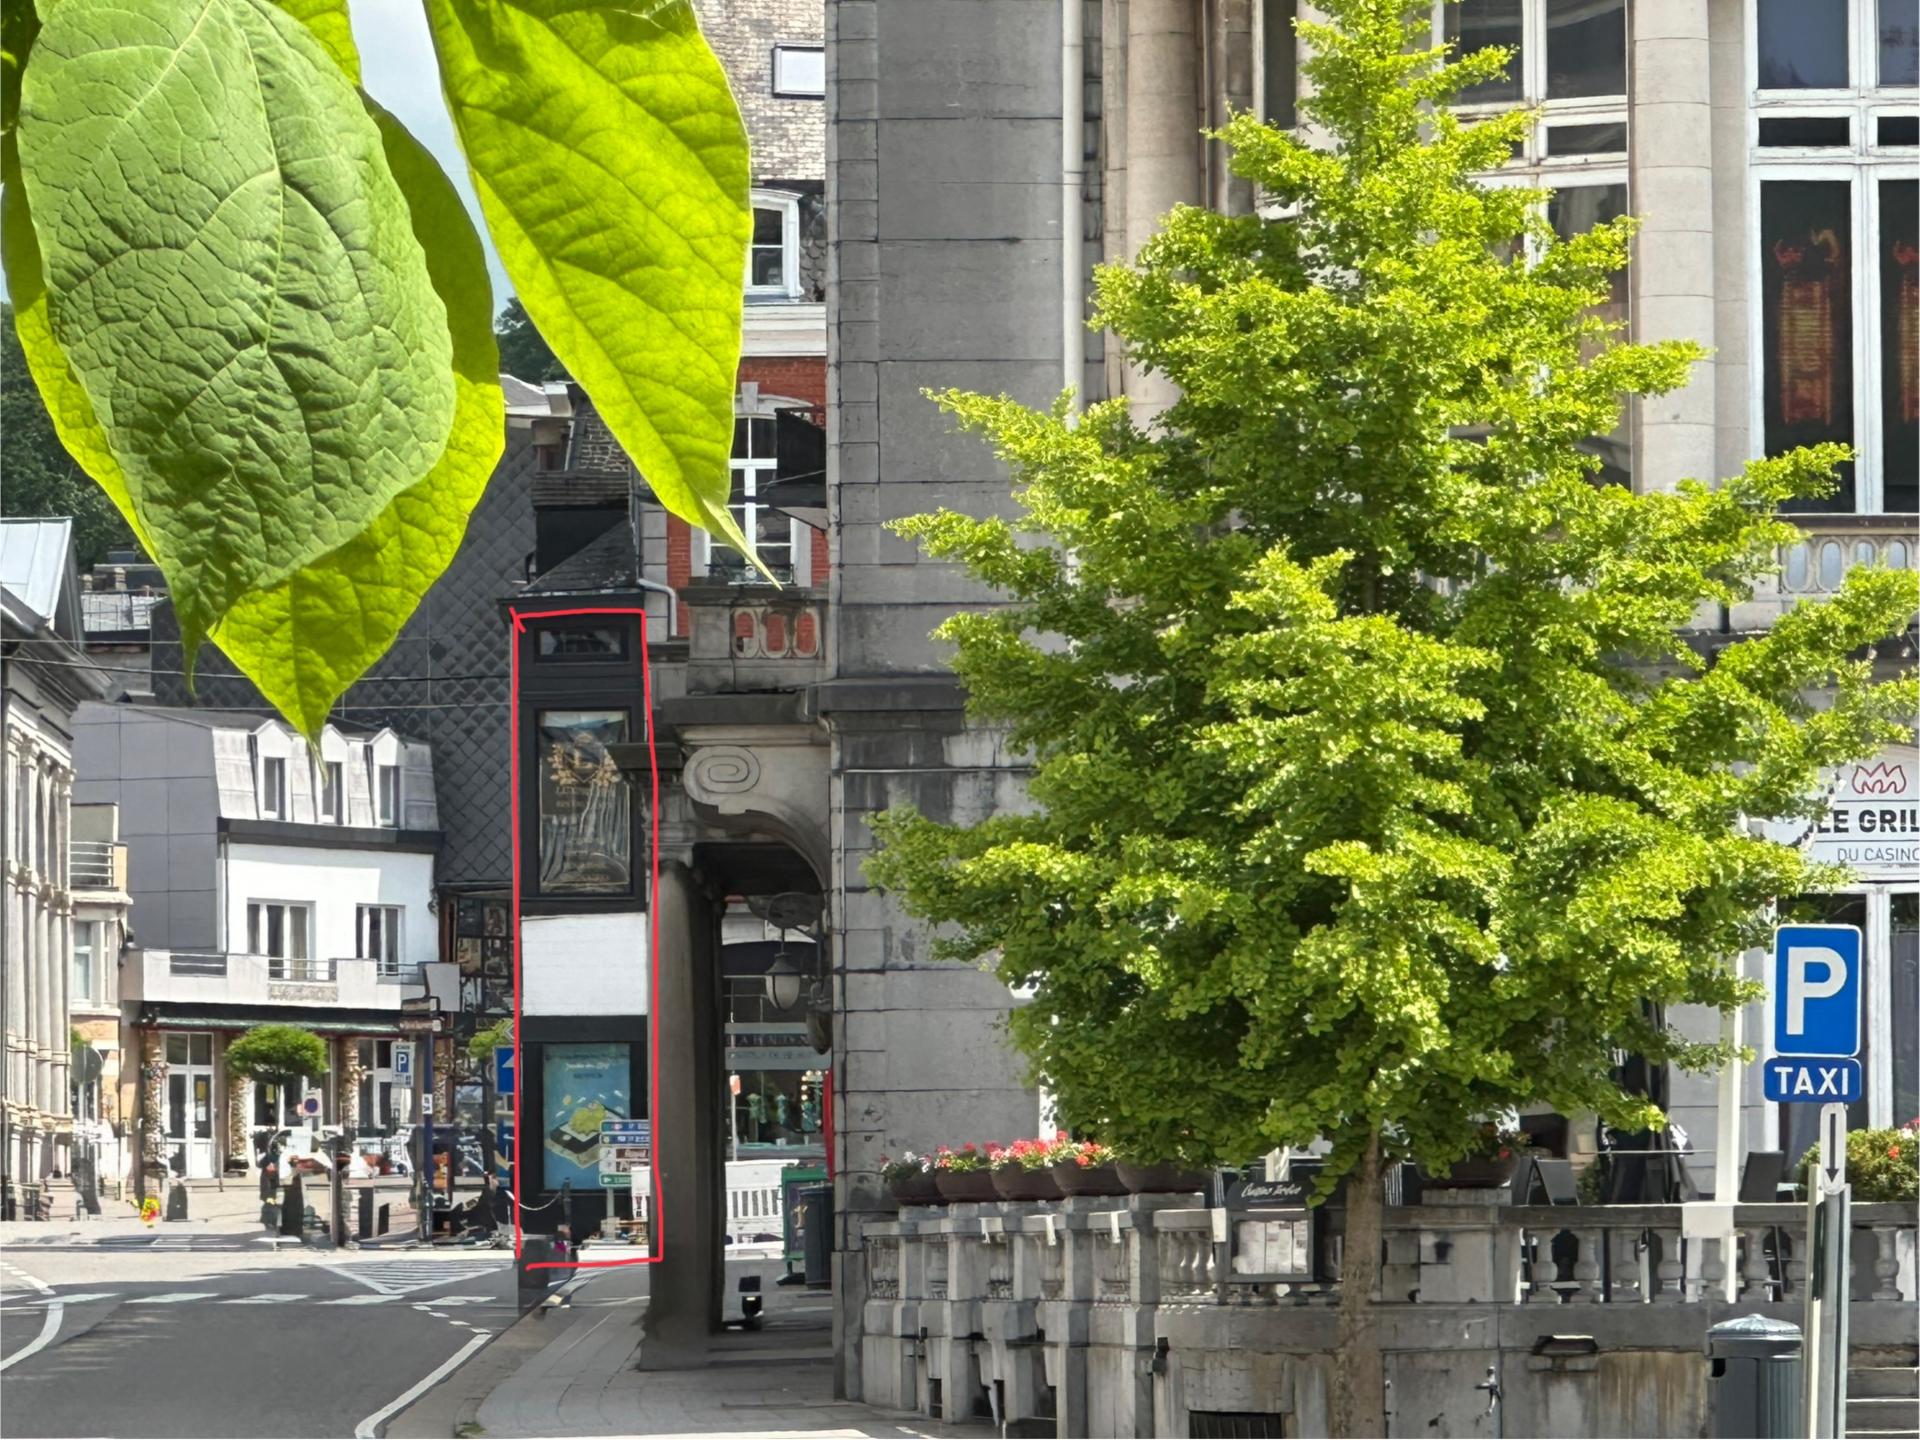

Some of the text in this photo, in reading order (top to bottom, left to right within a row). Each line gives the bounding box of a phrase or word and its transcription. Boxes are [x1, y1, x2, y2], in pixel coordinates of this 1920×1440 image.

[1837, 847, 1858, 861] DU
[1786, 945, 1848, 1036] P
[398, 1054, 407, 1072] P
[1774, 1065, 1849, 1096] TAXI
